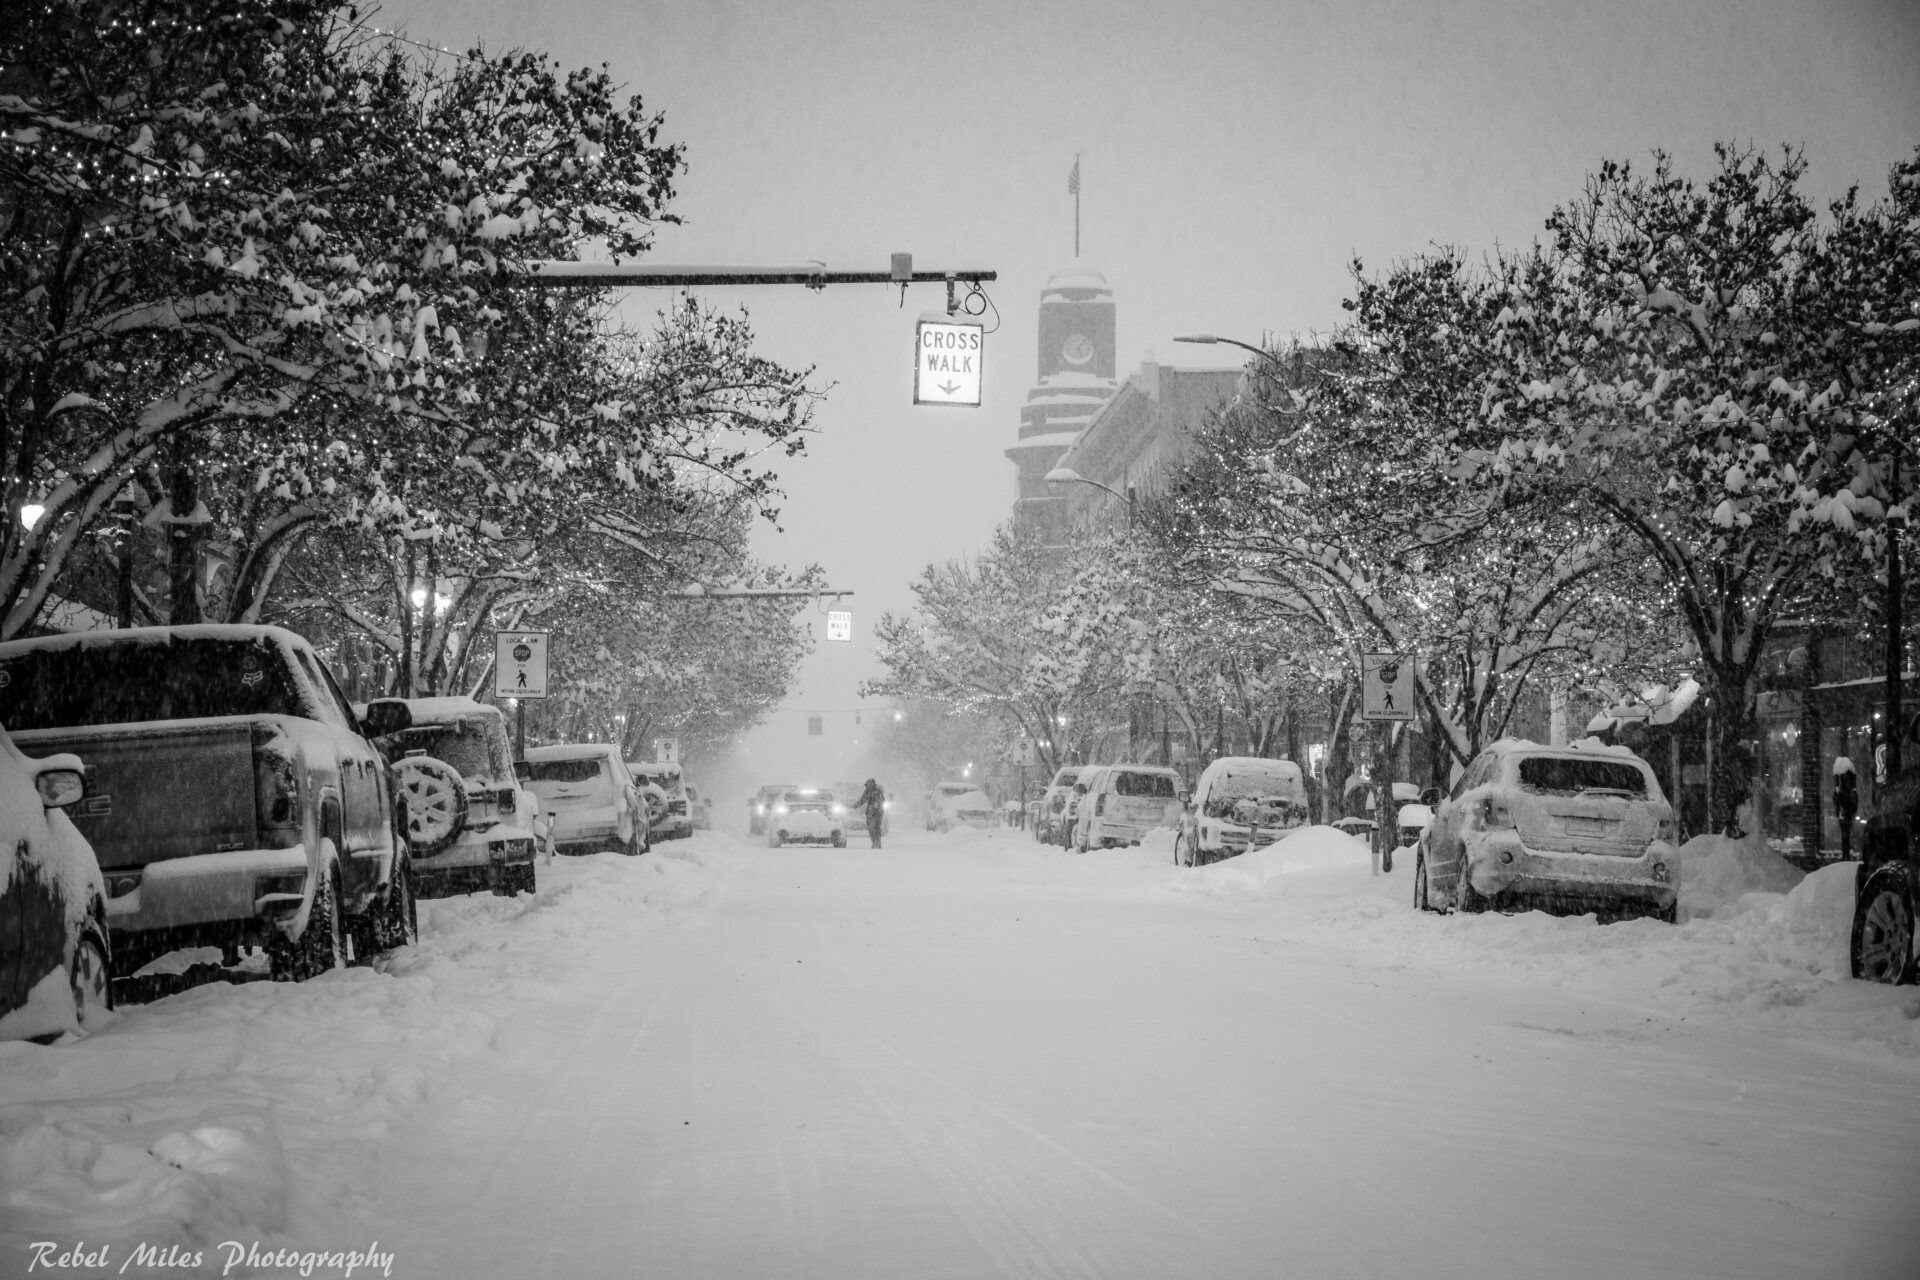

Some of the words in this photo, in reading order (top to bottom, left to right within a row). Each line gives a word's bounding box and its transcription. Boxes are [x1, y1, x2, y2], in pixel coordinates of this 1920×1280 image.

[923, 331, 979, 350] CROSS
[927, 354, 972, 373] WALK
[829, 613, 851, 621] CROSS
[831, 622, 848, 630] WALK
[515, 649, 529, 657] STOP
[1381, 671, 1397, 679] STOP
